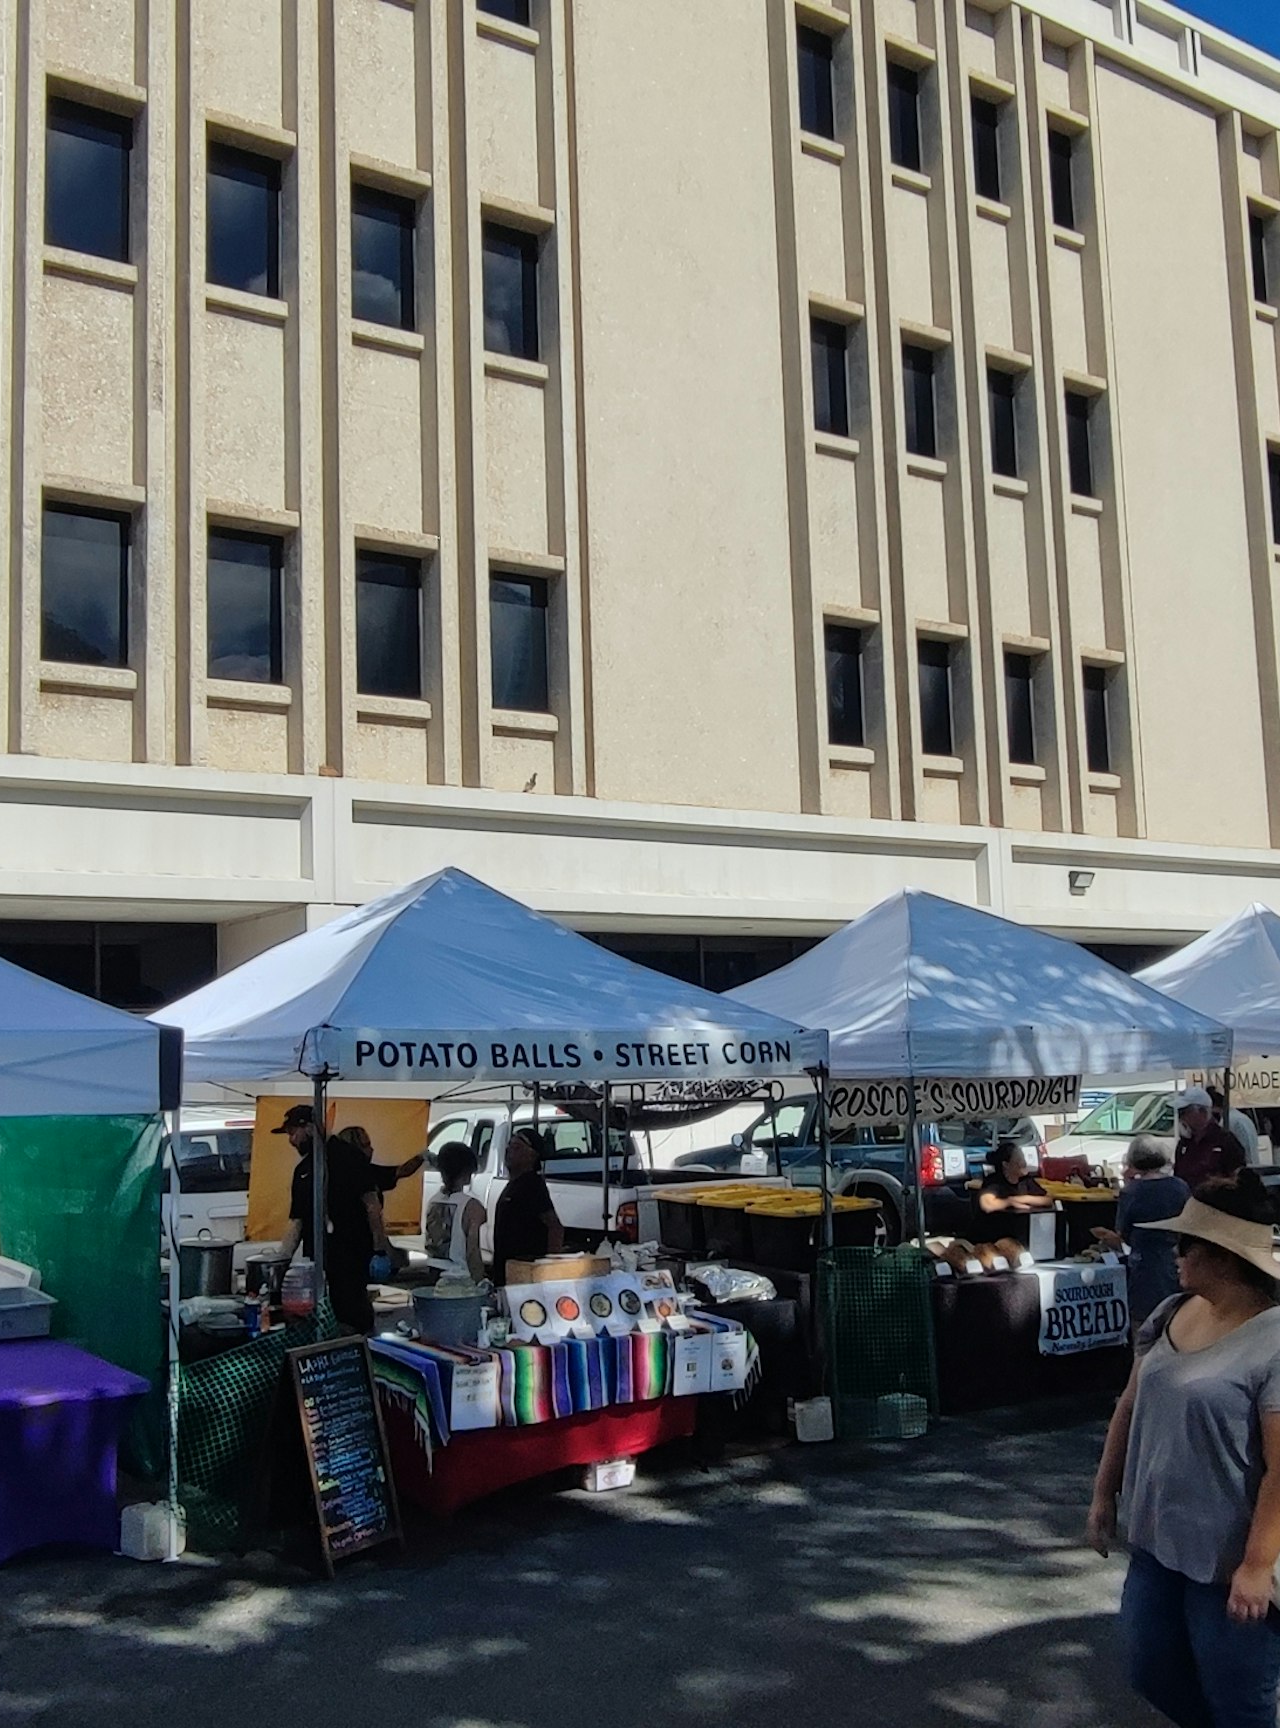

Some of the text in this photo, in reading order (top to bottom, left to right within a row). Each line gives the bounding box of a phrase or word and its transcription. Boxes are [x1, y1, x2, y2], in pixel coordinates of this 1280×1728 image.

[356, 1040, 792, 1069] POTATO BALLS STREET CORN
[951, 1075, 1078, 1114] SOURDOUGH
[1055, 1282, 1114, 1303] SOURDOUGH
[1044, 1299, 1127, 1340] BREAD
